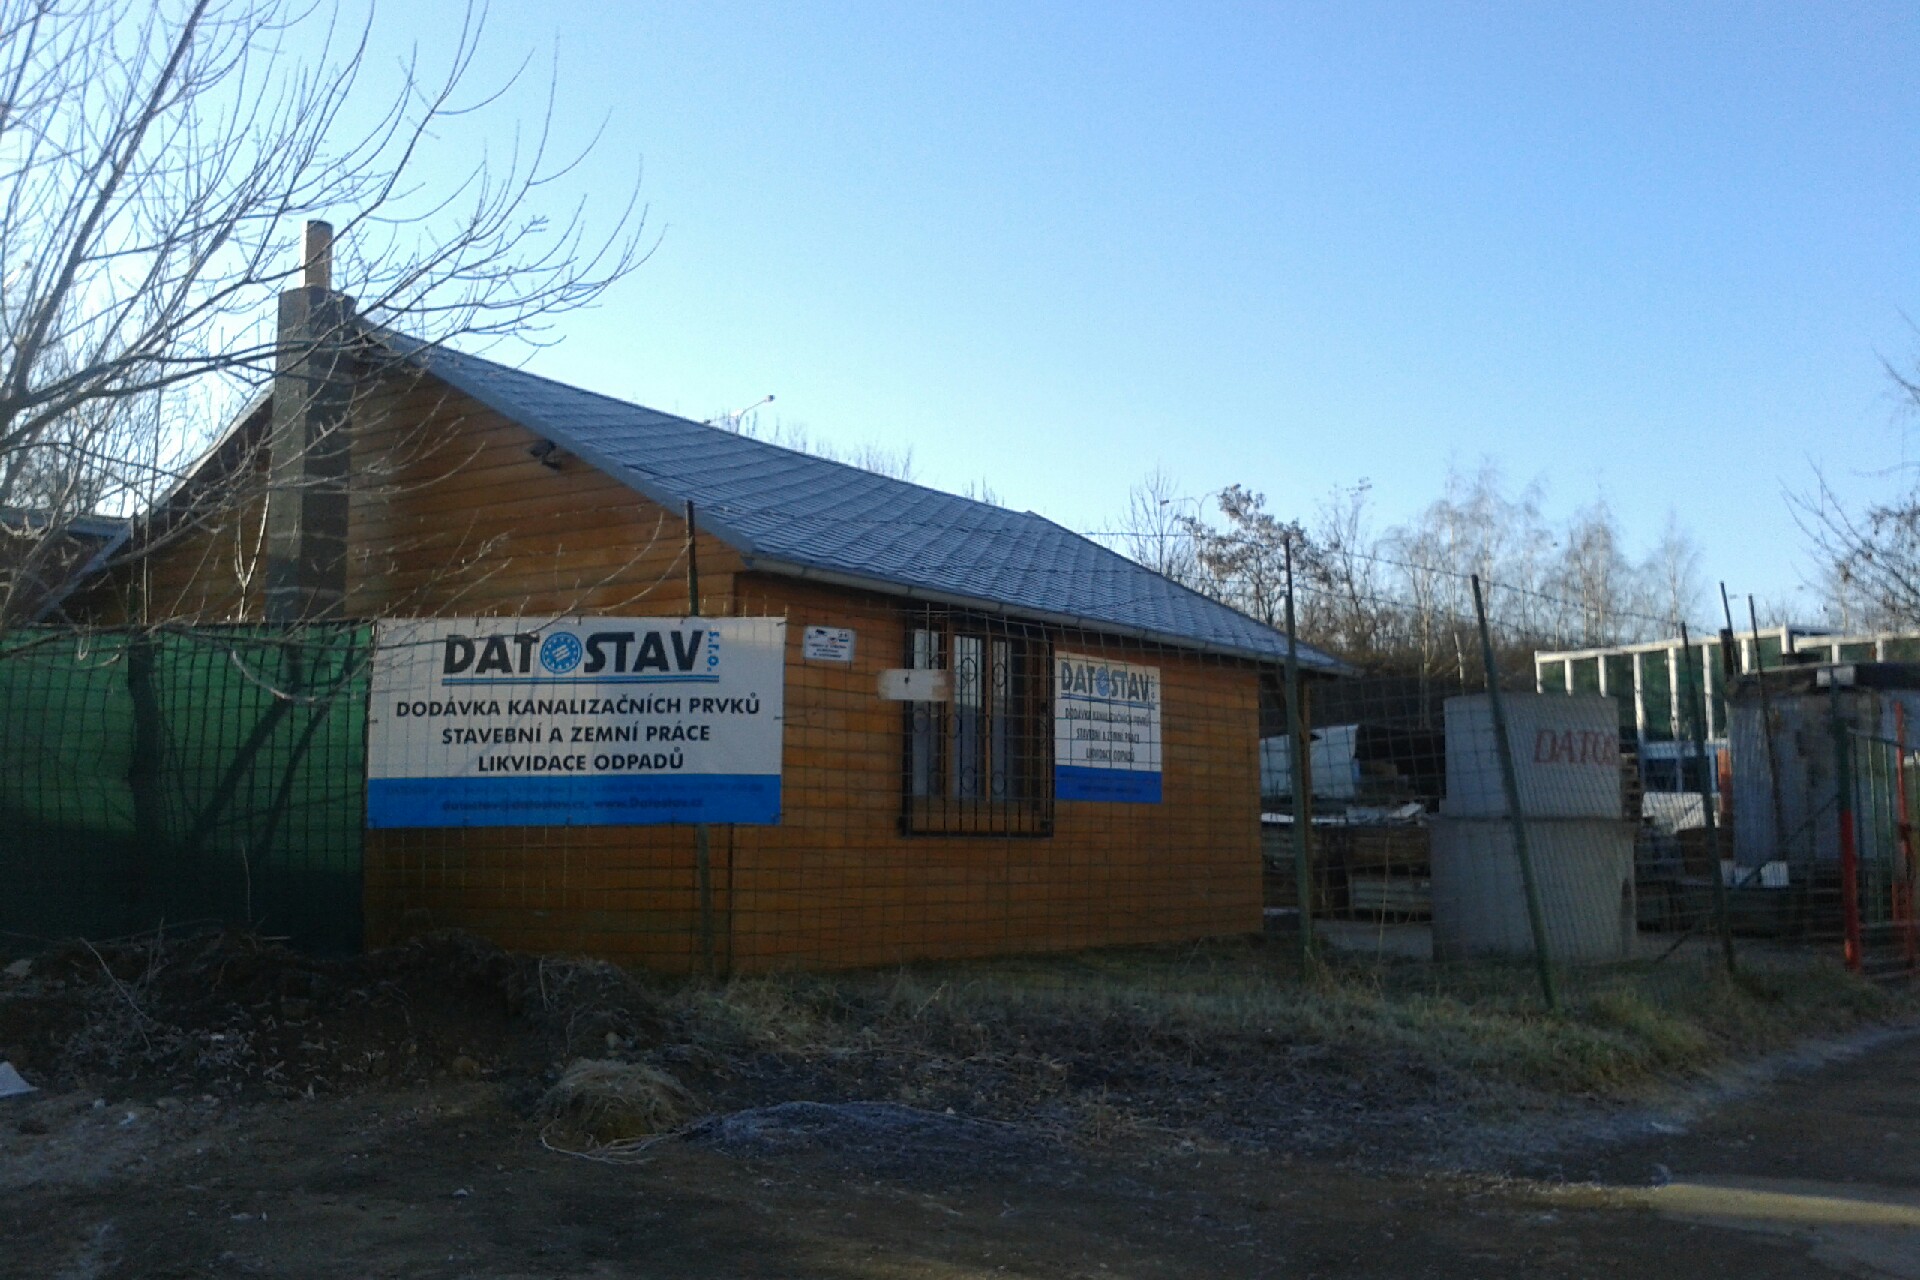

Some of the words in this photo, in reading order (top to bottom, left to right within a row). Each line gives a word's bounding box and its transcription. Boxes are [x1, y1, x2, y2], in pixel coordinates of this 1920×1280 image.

[706, 631, 720, 672] s.r.o.
[396, 696, 500, 717] DODÁVKA
[508, 694, 682, 716] KANALIZAČNÍCH
[689, 691, 760, 715] PRVKŮ
[442, 721, 541, 745] STAVEBNÍ
[550, 726, 563, 743] A
[571, 722, 638, 742] ZEMNÍ
[646, 721, 710, 741] PRÁCE
[478, 754, 586, 773] LIKVIDACE
[594, 746, 684, 770] ODPADŮ
